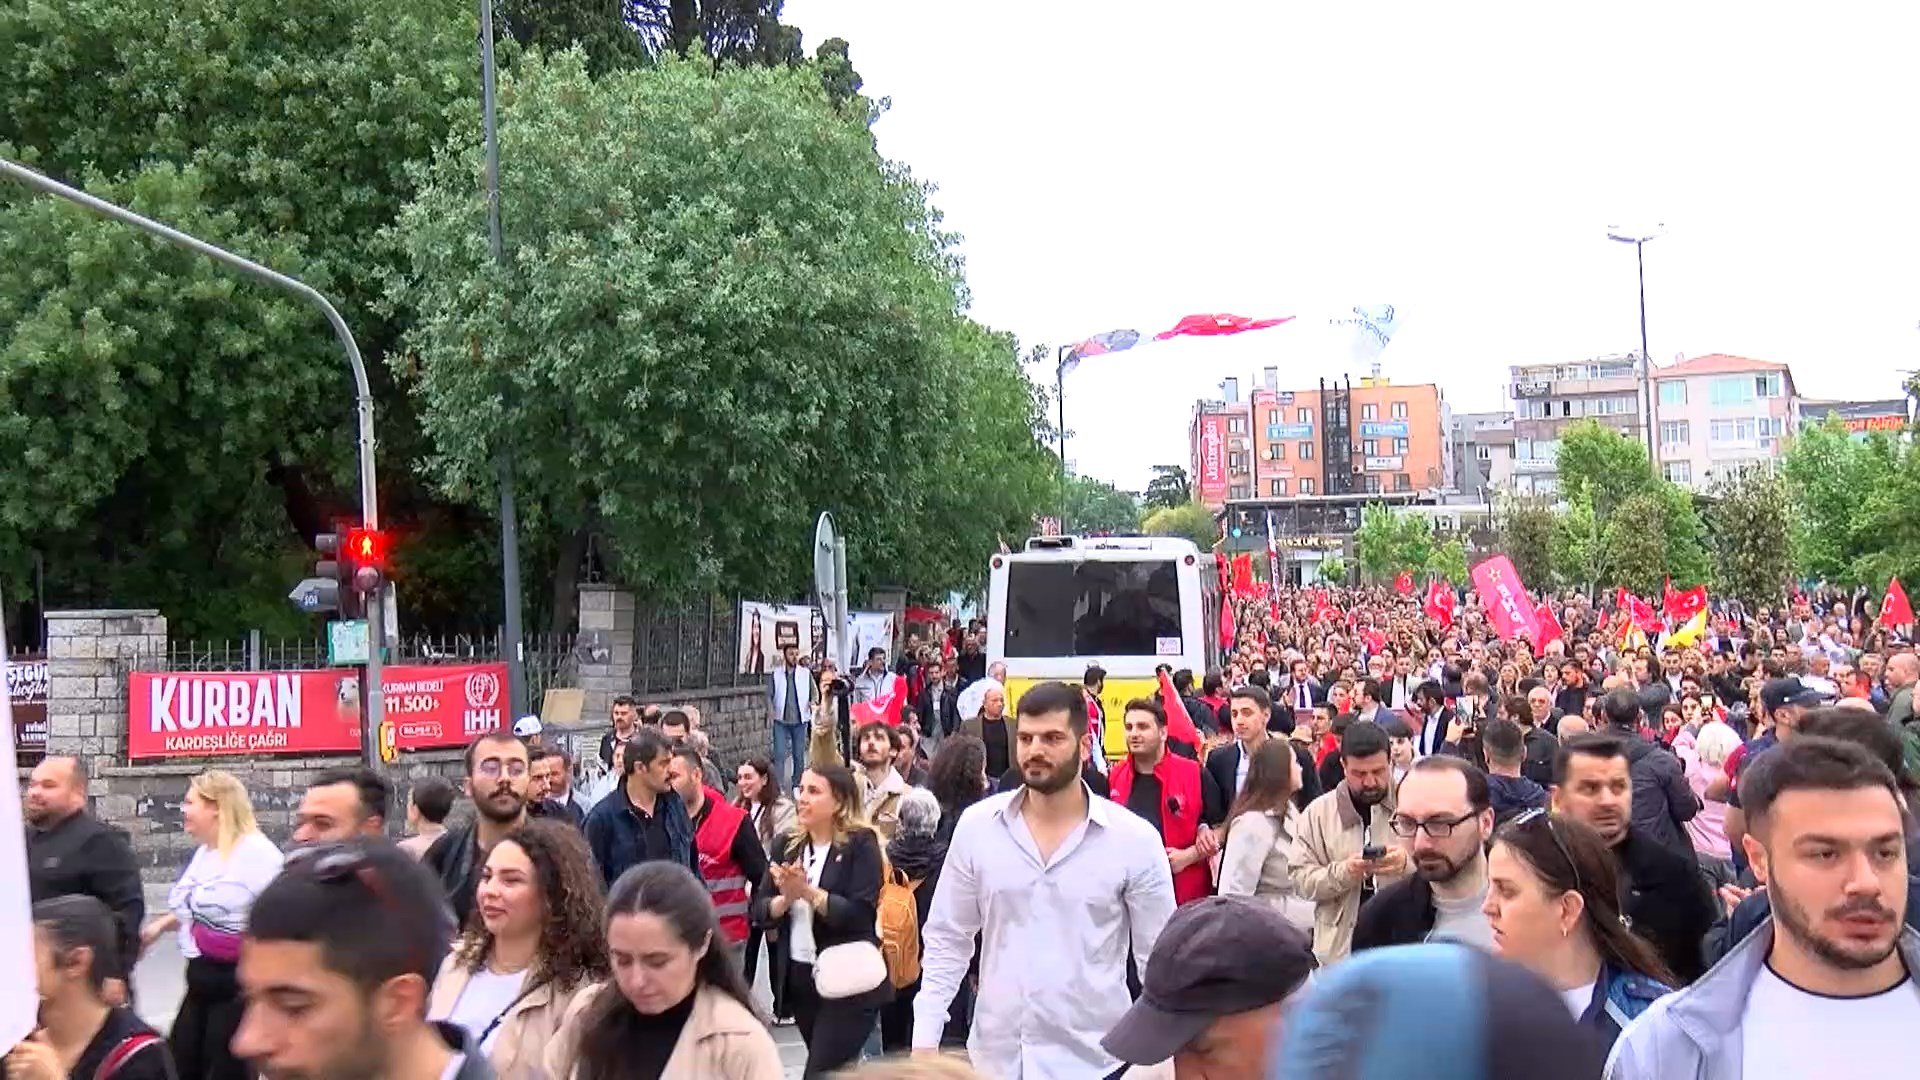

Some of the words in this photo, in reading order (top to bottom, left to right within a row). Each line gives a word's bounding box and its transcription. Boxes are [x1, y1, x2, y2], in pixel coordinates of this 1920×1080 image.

[417, 679, 444, 693] BEDELİ
[151, 673, 301, 733] KURBAN
[165, 732, 246, 753] KARDEŞLİĞE
[249, 730, 287, 751] ÇAĞRI
